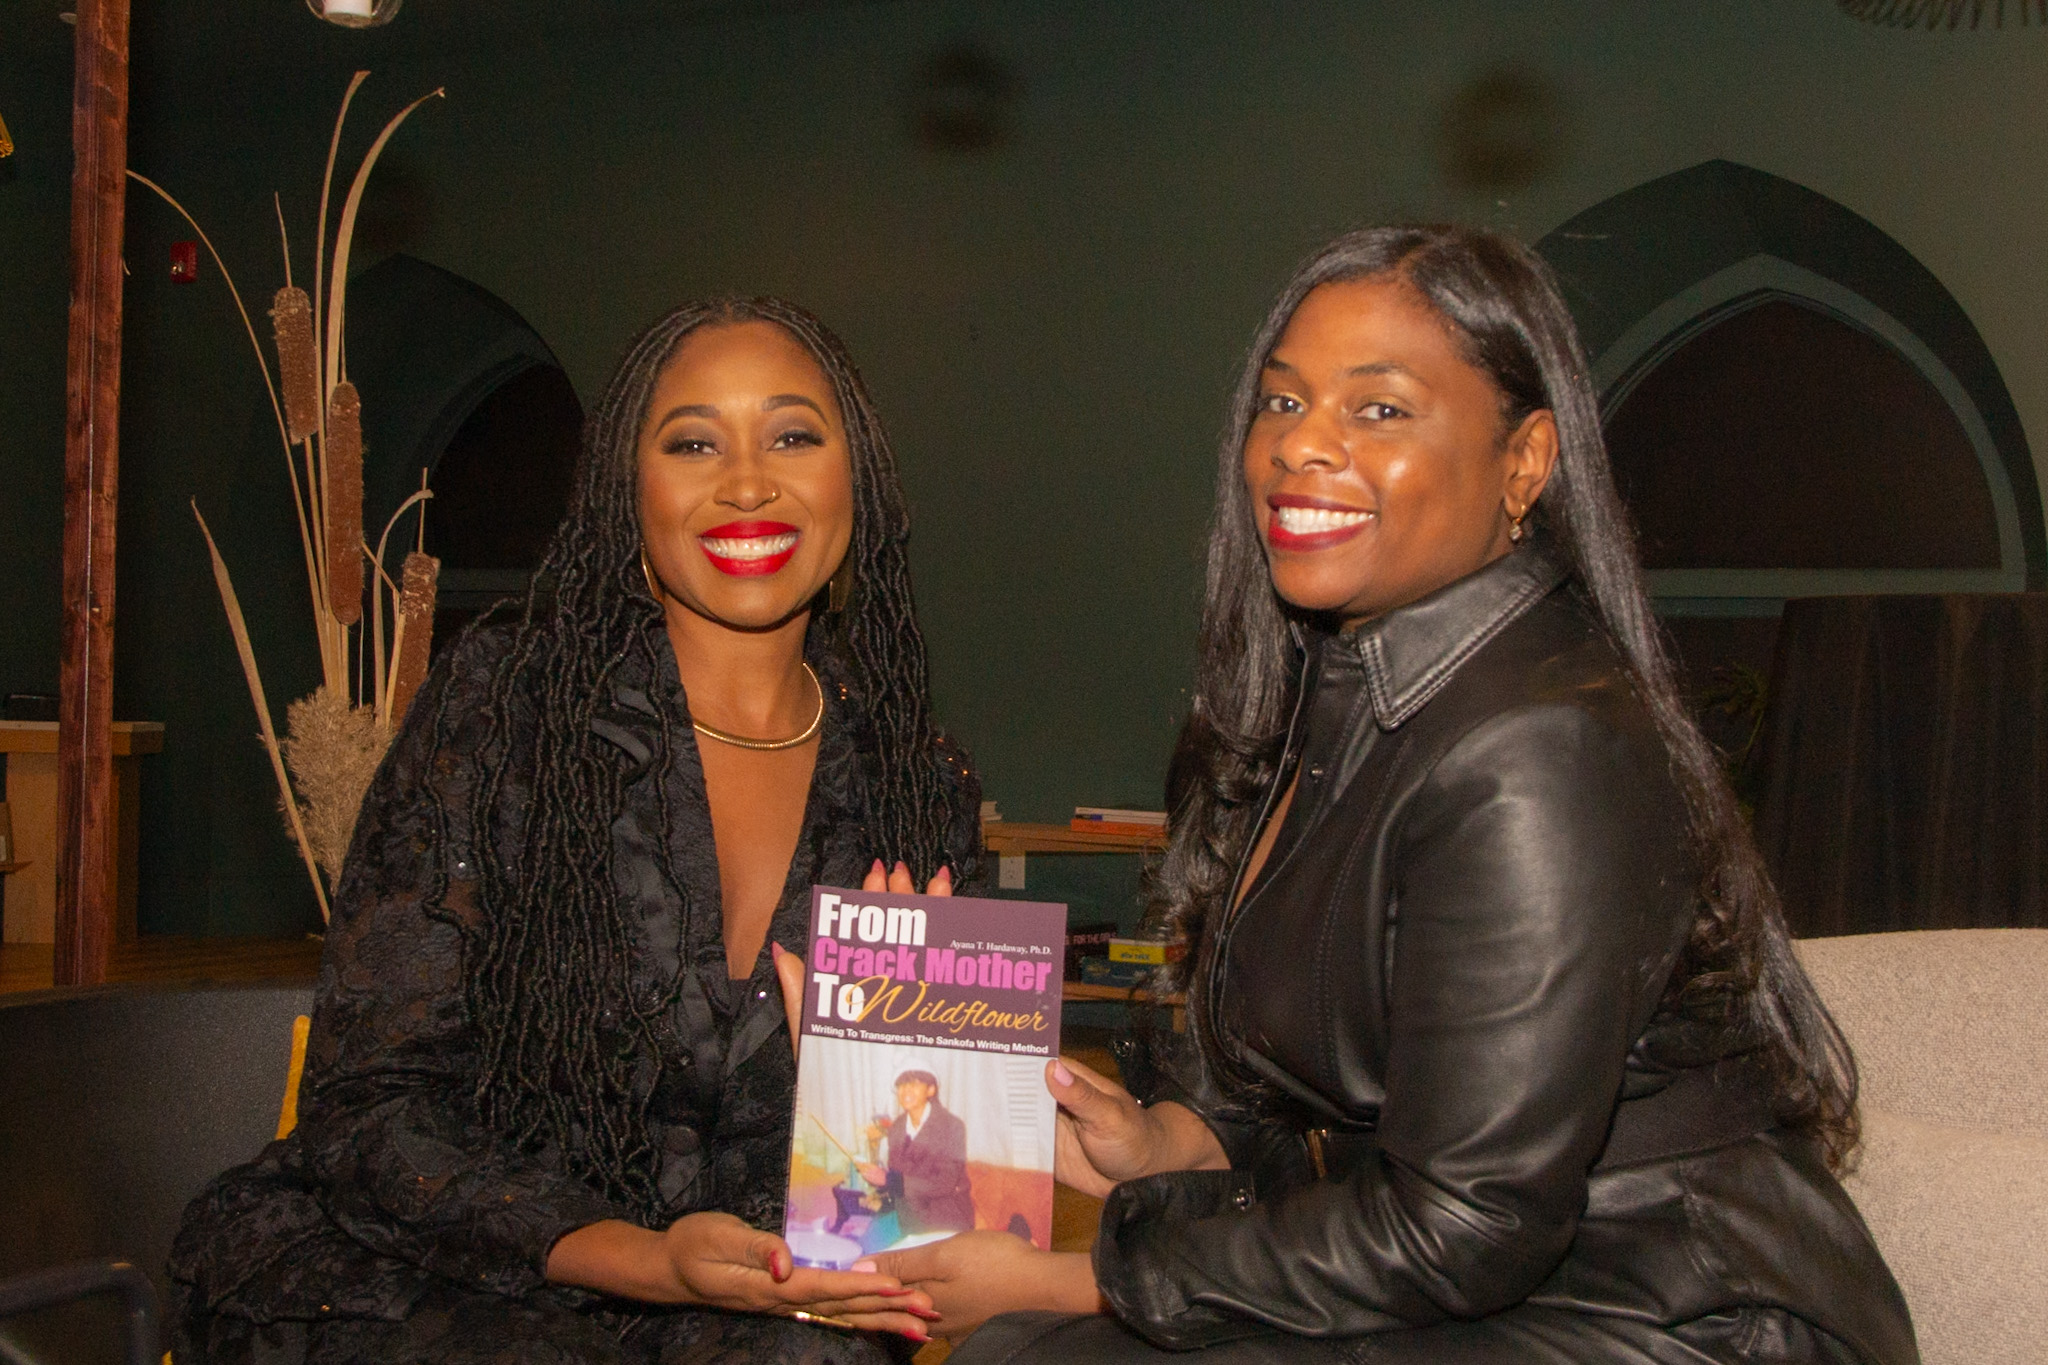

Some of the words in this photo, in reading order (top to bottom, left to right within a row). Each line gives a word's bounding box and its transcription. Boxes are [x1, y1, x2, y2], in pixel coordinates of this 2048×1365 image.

[818, 893, 927, 946] From
[814, 937, 917, 981] Crack
[925, 947, 1052, 991] Mother
[950, 940, 975, 950] Ayana
[976, 941, 984, 950] T.
[986, 942, 1028, 955] Hardaway,
[1030, 945, 1052, 955] Ph.D.
[813, 972, 865, 1021] To
[846, 975, 1049, 1033] Wildflower
[811, 1023, 844, 1038] Writing
[846, 1028, 858, 1038] To
[860, 1030, 914, 1043] Transgress:
[916, 1034, 934, 1045] The
[936, 1036, 975, 1048] Sankofa
[976, 1040, 1010, 1052] Writing
[1012, 1043, 1049, 1054] Method
